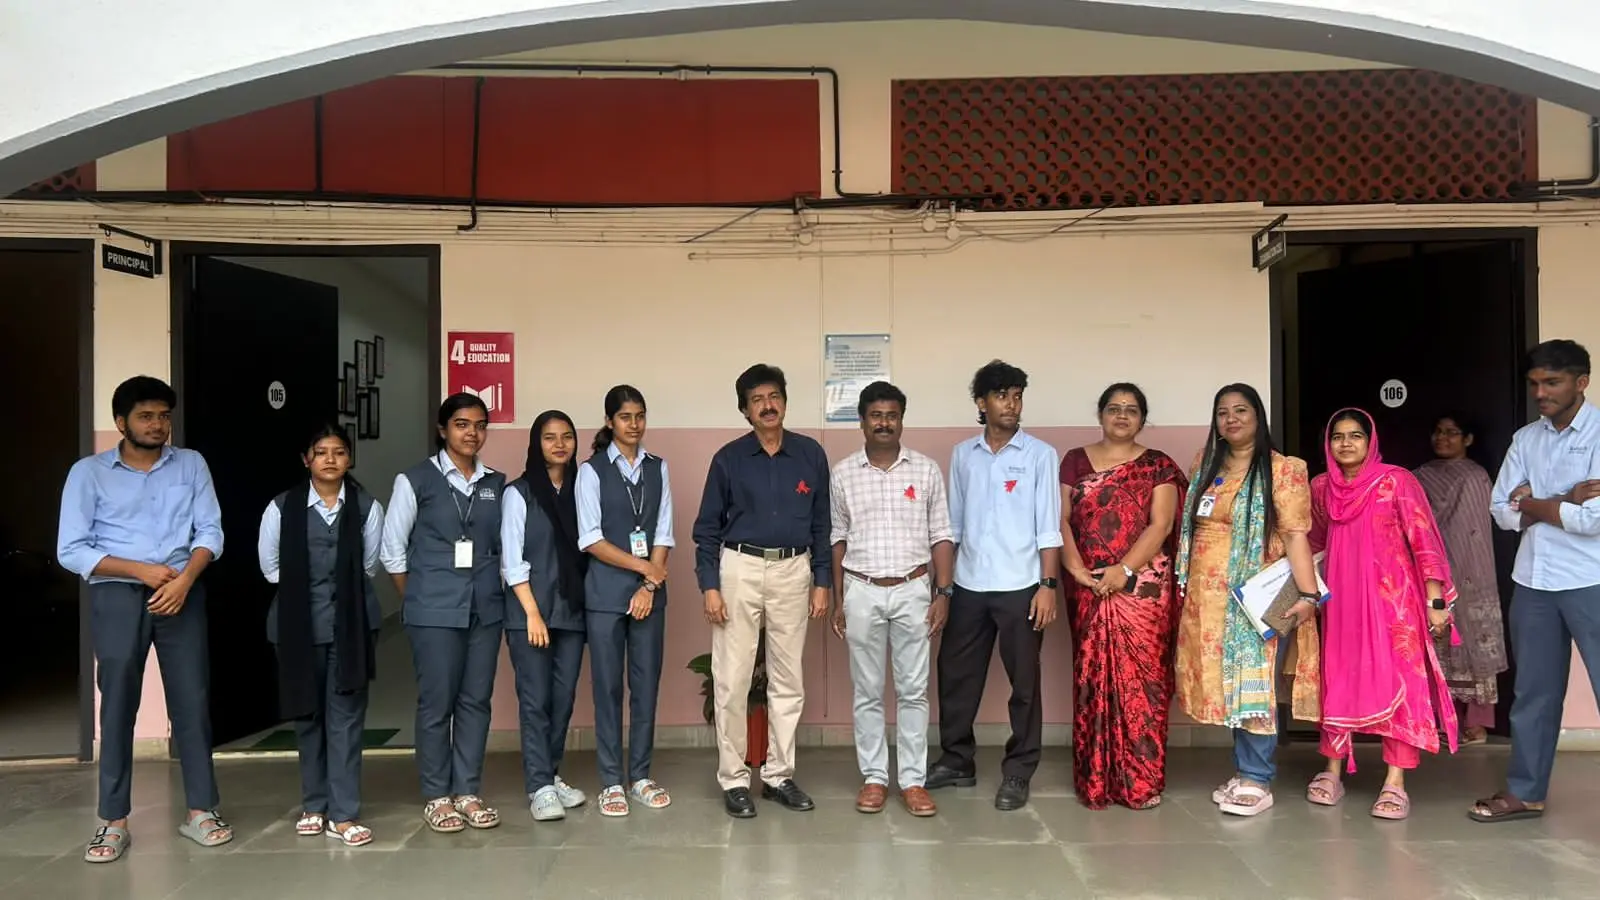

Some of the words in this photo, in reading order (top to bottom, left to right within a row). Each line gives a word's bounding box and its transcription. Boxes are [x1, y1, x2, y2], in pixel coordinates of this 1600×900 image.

[107, 252, 150, 271] PRINCIPAL
[450, 340, 466, 365] 4
[469, 343, 497, 352] QUALITY
[467, 353, 511, 363] EDUCATION
[271, 388, 283, 402] 105
[1383, 386, 1404, 400] 106
